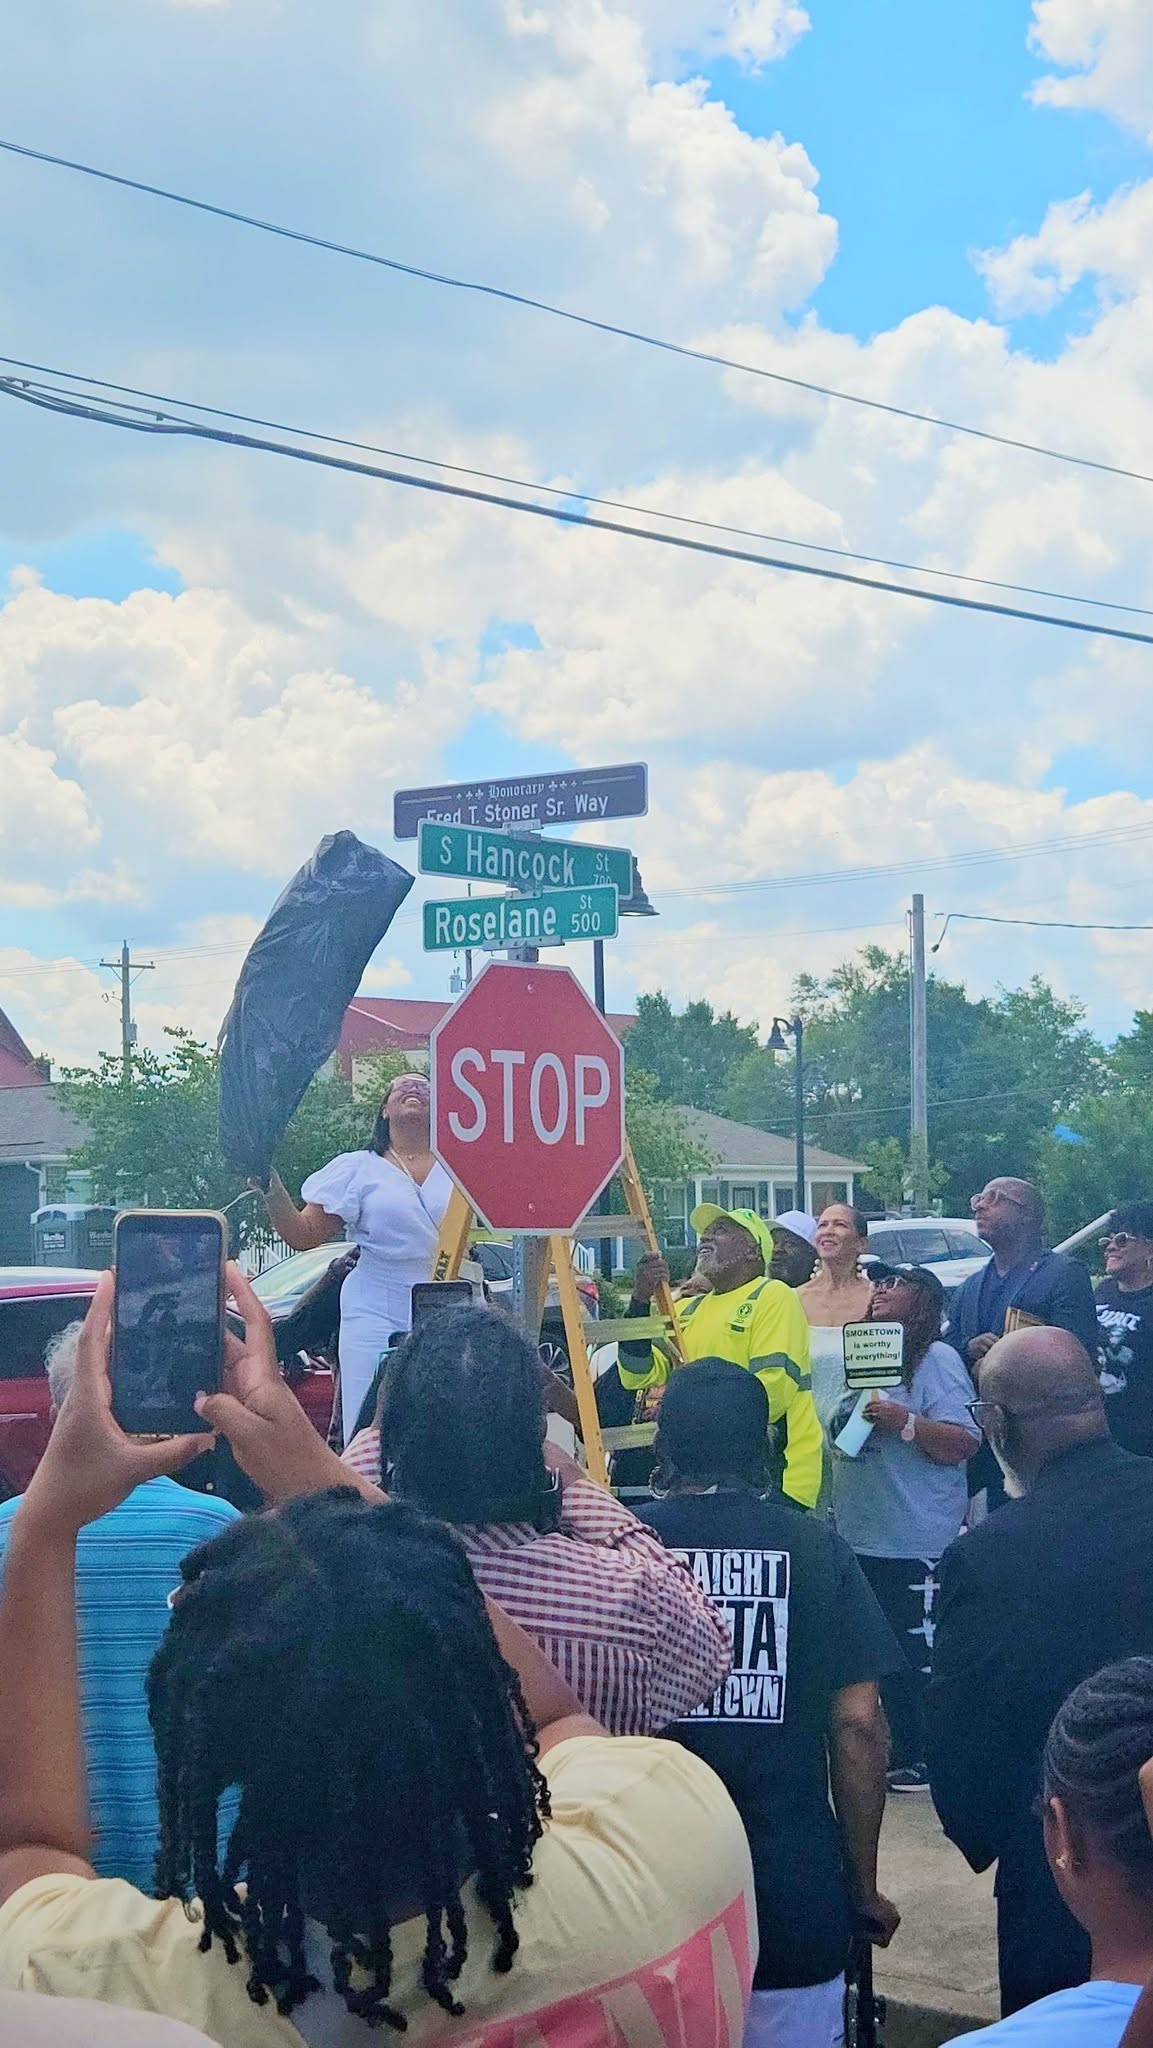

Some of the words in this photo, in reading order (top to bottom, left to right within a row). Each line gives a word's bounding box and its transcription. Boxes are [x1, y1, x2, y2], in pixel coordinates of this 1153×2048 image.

[488, 782, 544, 800] Honorary
[427, 807, 461, 825] Fred
[468, 805, 480, 825] T.
[485, 803, 538, 823] Stoner
[546, 798, 566, 816] Sr.
[575, 793, 608, 816] Way
[440, 835, 452, 865] S
[466, 833, 575, 886] Hancock
[595, 852, 610, 873] St
[435, 902, 557, 944] Roselane
[580, 894, 592, 909] St
[571, 913, 601, 933] 500
[448, 1047, 611, 1145] STOP
[845, 1329, 900, 1337] SMOKETOWN
[863, 1341, 891, 1349] worthy
[856, 1352, 900, 1360] everything!
[674, 1551, 783, 1596] AIGHT
[717, 1601, 779, 1671] TA
